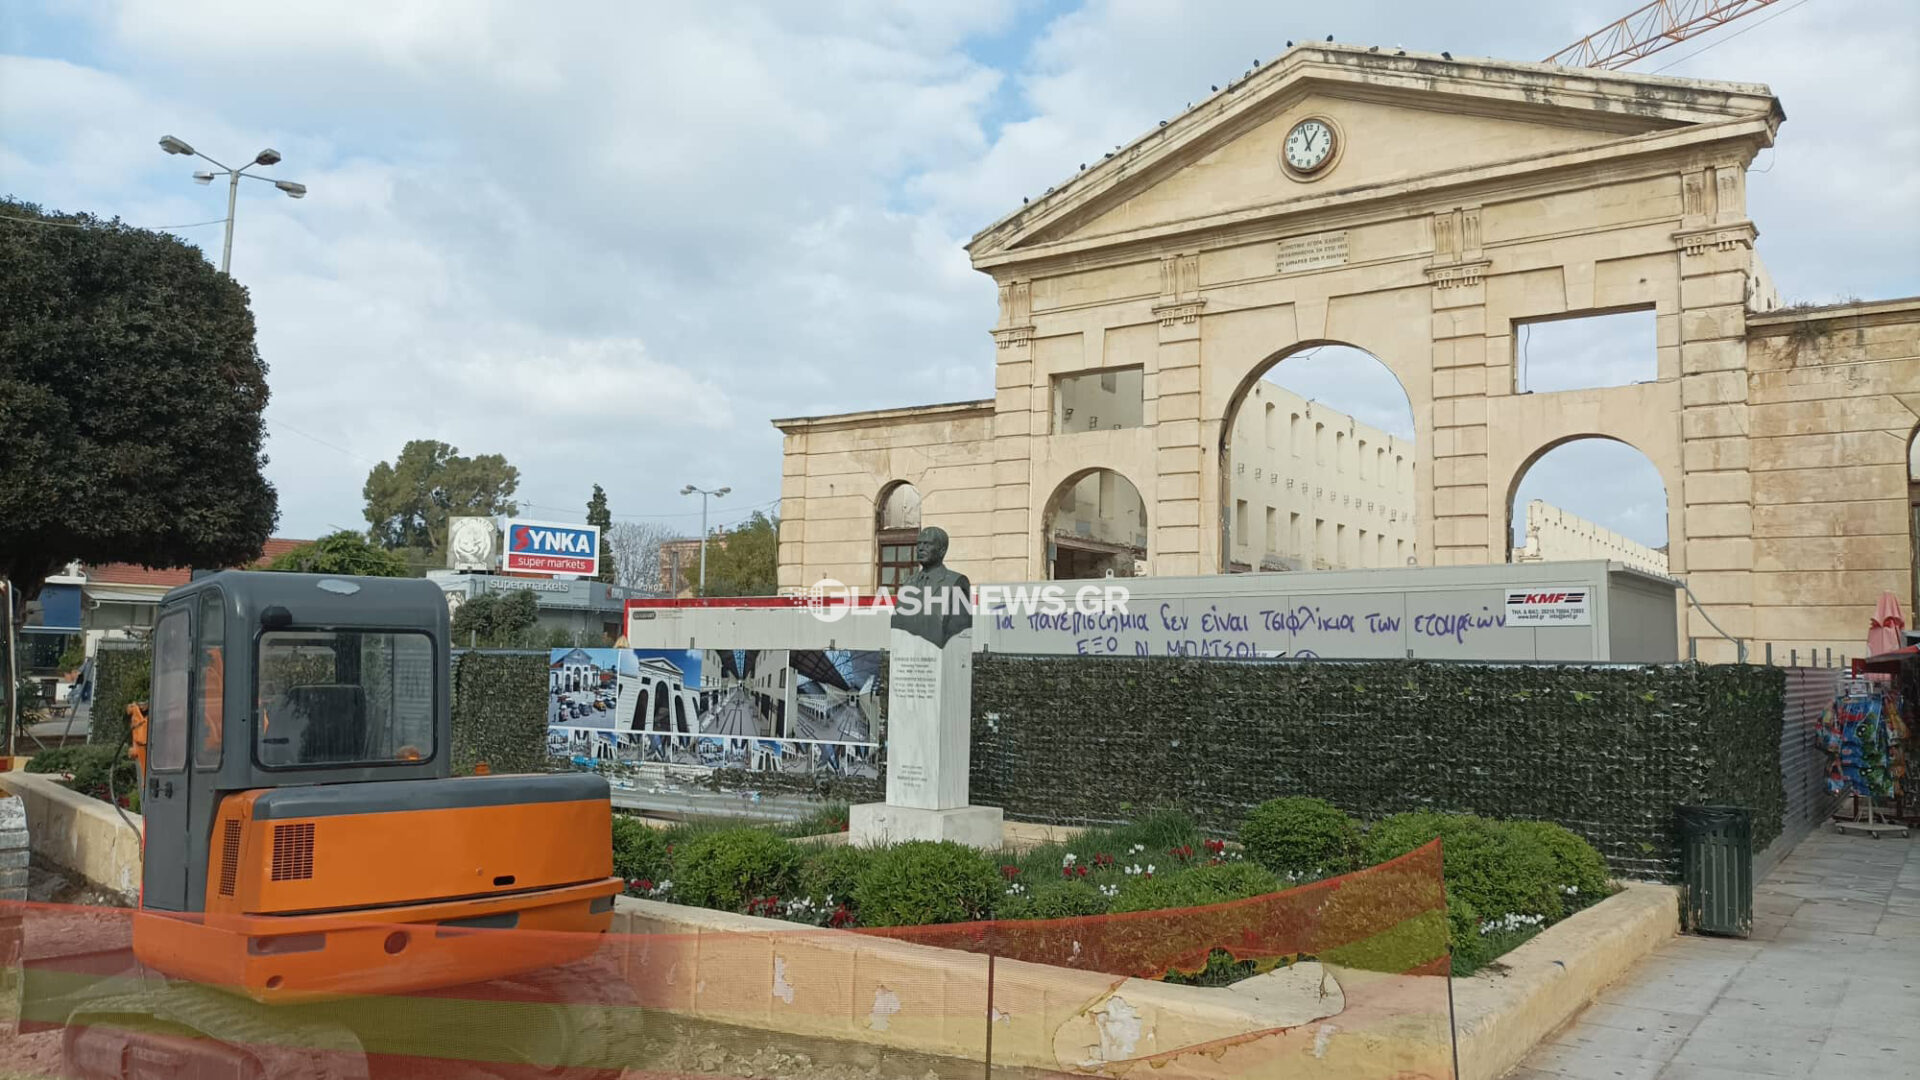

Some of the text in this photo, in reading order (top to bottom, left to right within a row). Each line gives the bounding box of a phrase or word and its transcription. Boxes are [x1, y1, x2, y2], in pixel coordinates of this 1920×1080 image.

[514, 526, 591, 554] SYNKA
[518, 557, 586, 570] super markets
[489, 579, 569, 592] super markets
[1525, 593, 1566, 604] KMF
[1160, 603, 1188, 632] δεν
[1201, 605, 1249, 632] είναι
